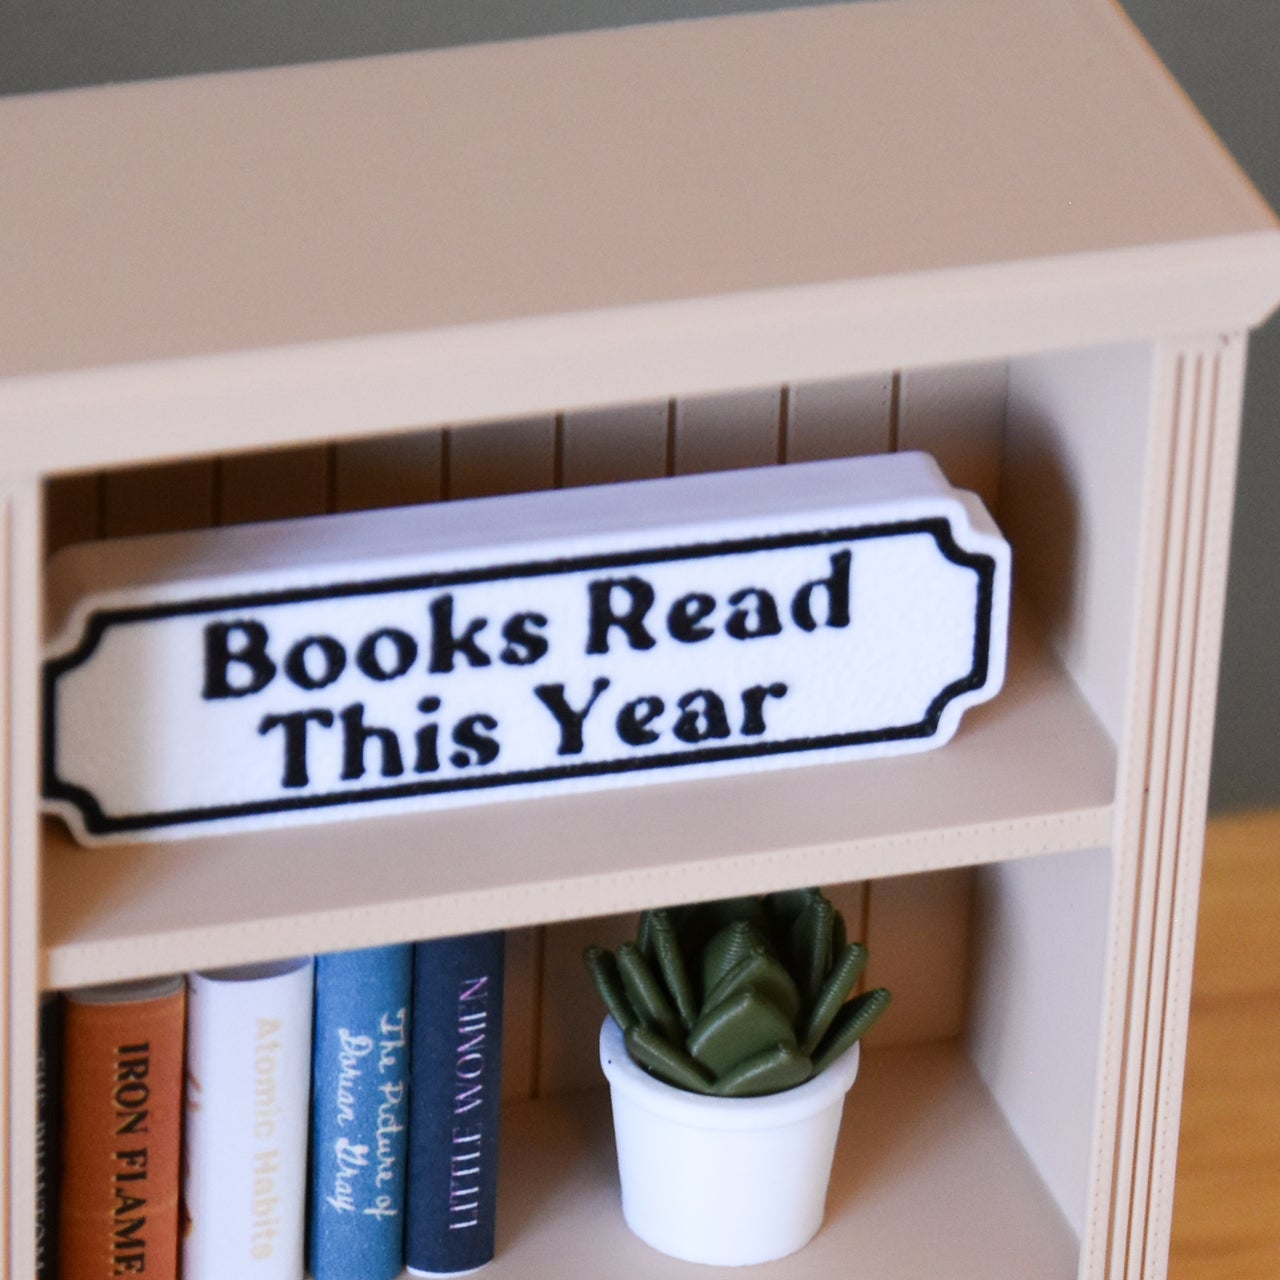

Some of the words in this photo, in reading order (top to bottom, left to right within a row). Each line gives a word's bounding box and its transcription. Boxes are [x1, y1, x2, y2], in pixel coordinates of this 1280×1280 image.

[203, 593, 549, 701] Books
[585, 548, 852, 656] Read
[257, 695, 501, 789] This
[533, 676, 788, 755] Year
[114, 1041, 150, 1136] IRON
[254, 1017, 281, 1140] Atomic
[336, 1027, 373, 1128] Dorian
[378, 1008, 407, 1074] The
[454, 976, 489, 1114] WOMEN
[327, 1137, 370, 1215] Gray
[375, 1080, 405, 1188] Picture
[448, 1123, 483, 1230] LITTLE
[110, 1147, 149, 1277] FLAME
[251, 1150, 280, 1261] Habits
[364, 1195, 399, 1221] of
